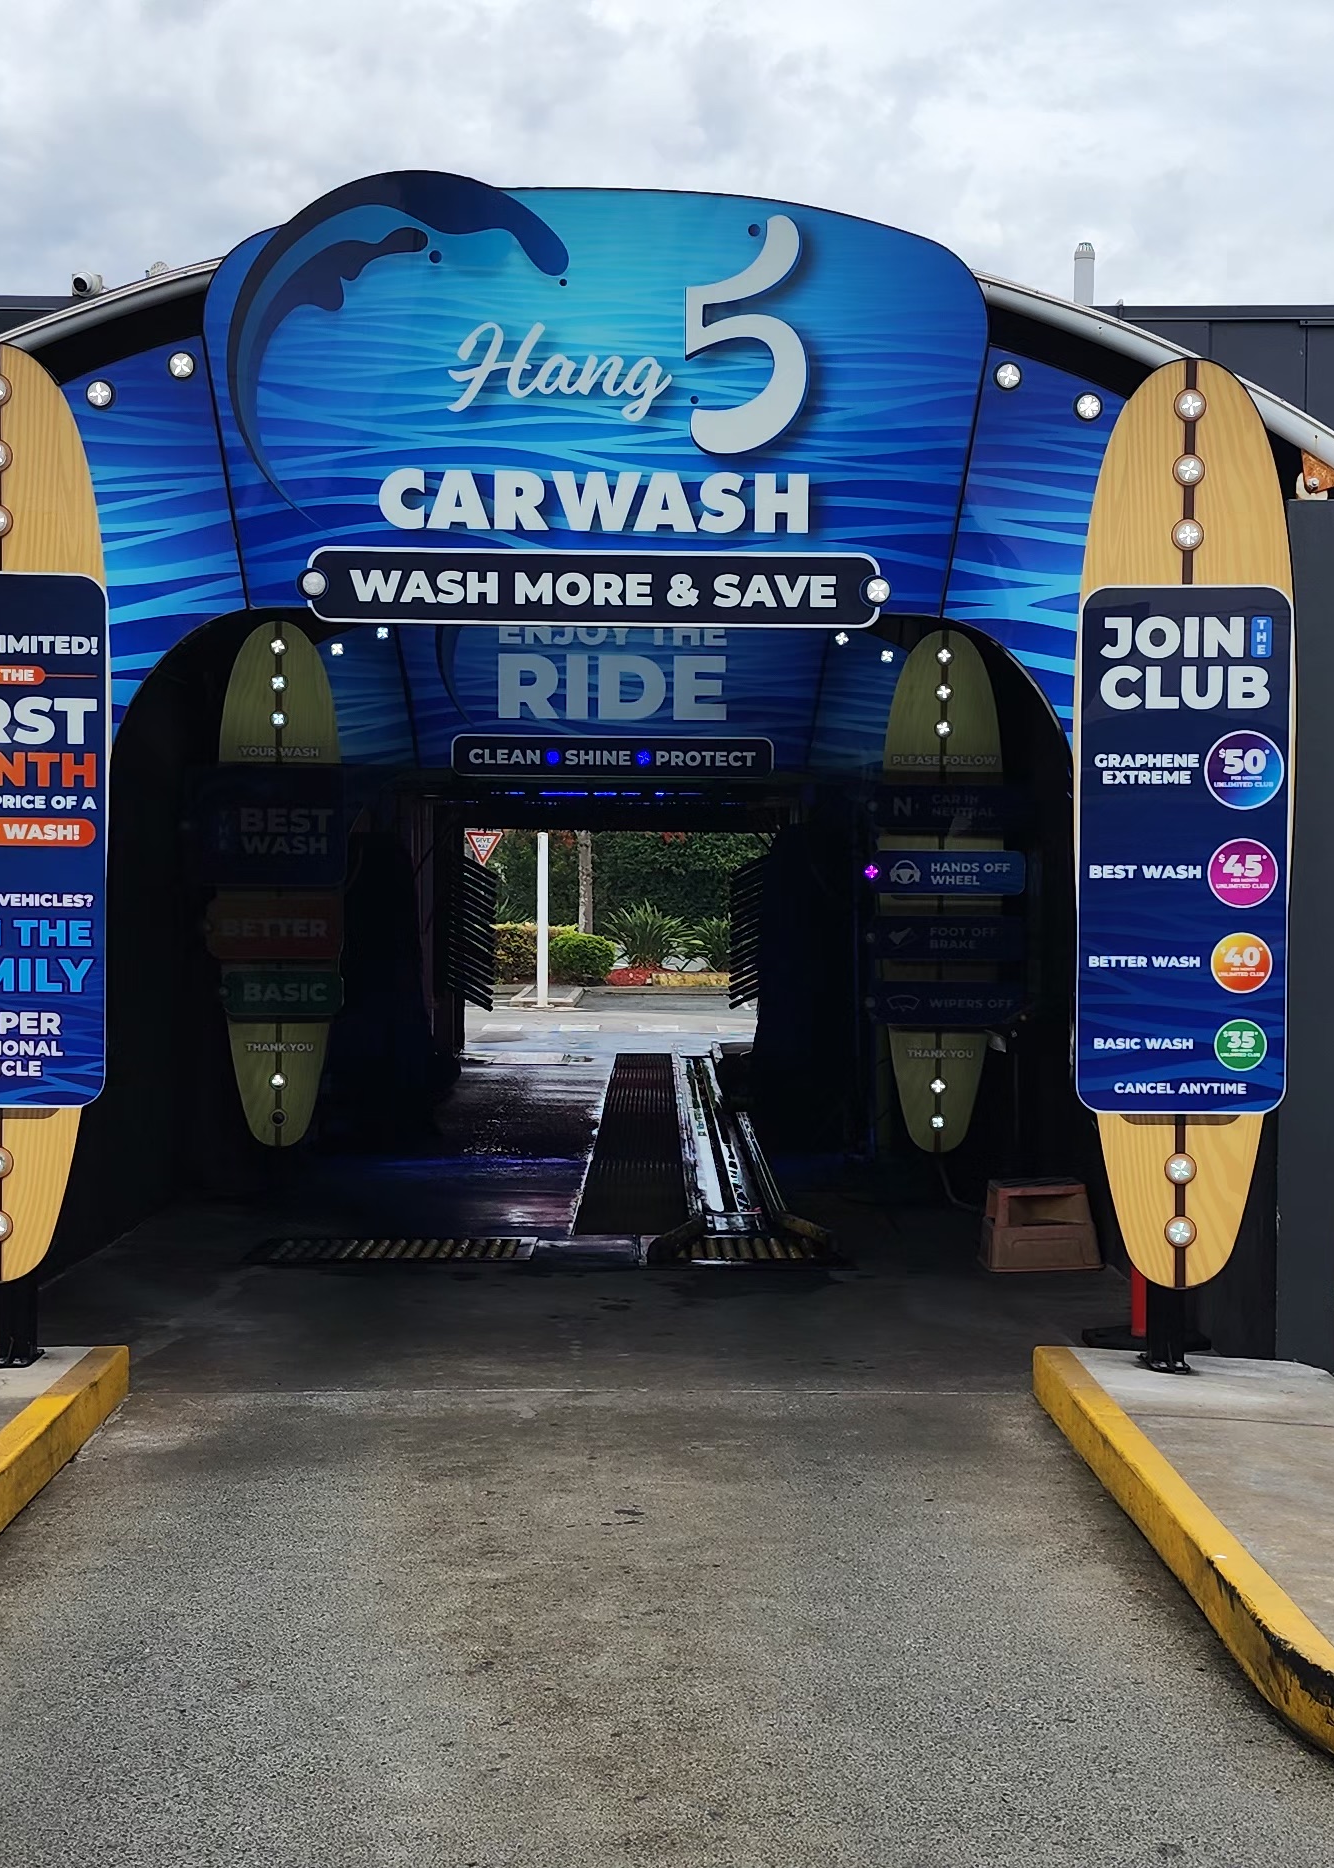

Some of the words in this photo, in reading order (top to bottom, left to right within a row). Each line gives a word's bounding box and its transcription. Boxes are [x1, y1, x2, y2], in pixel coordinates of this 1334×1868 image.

[447, 321, 673, 422] Hang
[685, 214, 809, 455] 5
[377, 467, 809, 534] CARWASH
[349, 569, 499, 605] WASH
[514, 571, 653, 606] MORE
[667, 573, 700, 607] &
[713, 574, 837, 609] SAVE
[498, 626, 630, 646] ENJOY
[1100, 616, 1245, 659] JOIN
[1256, 619, 1267, 655] THE
[0, 668, 35, 682] THE
[498, 653, 727, 721] RIDE
[1100, 665, 1271, 711] CLUB
[240, 746, 276, 757] YOUR
[277, 747, 319, 757] WASH
[469, 748, 541, 765] CLEAN
[565, 750, 631, 766] SHINE
[656, 751, 756, 767] PROTECT
[892, 755, 939, 765] PLEASE
[942, 756, 997, 765] FOLLOW
[1094, 753, 1200, 768] GRAPHENE
[1102, 770, 1192, 785] EXTREME
[50, 795, 78, 810] OF
[81, 796, 97, 810] A
[240, 807, 334, 833] BEST
[2, 823, 81, 841] WASH!
[240, 835, 329, 855] WASH
[930, 862, 979, 873] HANDS
[983, 863, 1011, 873] OFF
[1089, 865, 1138, 879] BEST
[1142, 865, 1202, 879] WASH
[930, 875, 980, 885] WHEEL
[13, 919, 92, 947] THE
[219, 917, 329, 938] BETTER
[930, 927, 966, 937] FOOT
[971, 927, 998, 937] OFF
[929, 939, 977, 949] BRAKE
[1088, 955, 1147, 968] BETTER
[1151, 956, 1201, 968] WASH
[243, 982, 328, 1002] BASIC
[929, 999, 983, 1008] WIPERS
[987, 999, 1013, 1008] OFF
[0, 1011, 62, 1036] PER
[246, 1043, 287, 1052] THANK
[289, 1043, 314, 1052] YOU
[1093, 1037, 1141, 1050] BASIC
[1144, 1038, 1194, 1050] WASH
[907, 1049, 947, 1059] THANK
[949, 1050, 974, 1059] YOU
[1113, 1082, 1175, 1094] CANCEL
[1178, 1082, 1247, 1095] ANYTIME
